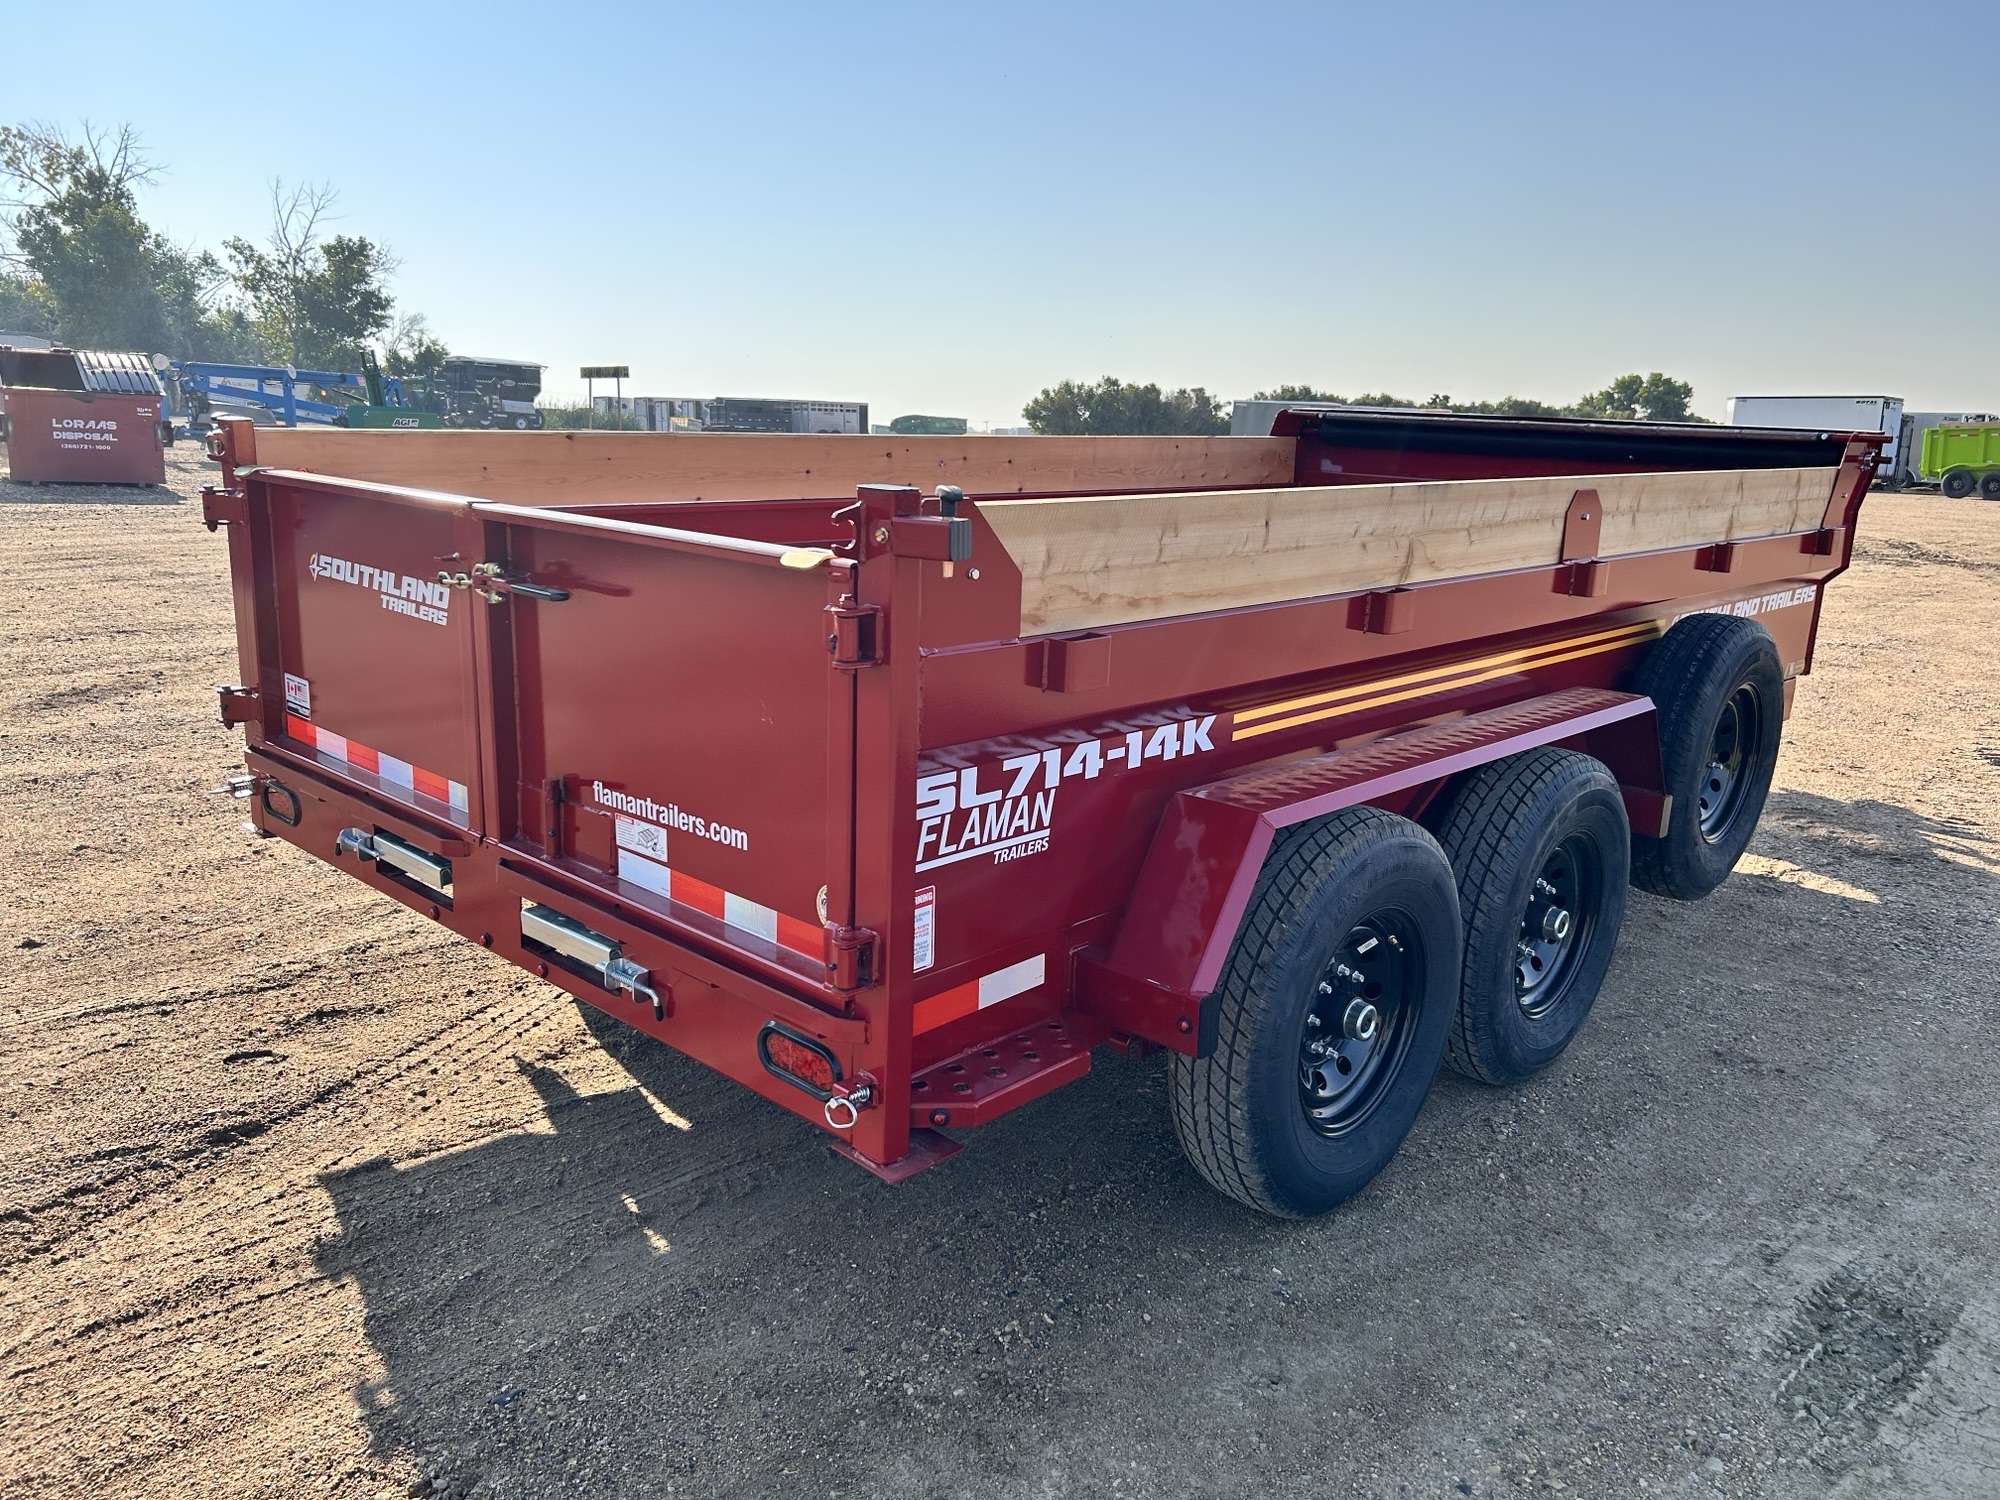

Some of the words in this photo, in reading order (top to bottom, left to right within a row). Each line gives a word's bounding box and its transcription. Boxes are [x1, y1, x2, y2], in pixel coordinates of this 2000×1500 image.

[52, 418, 118, 430] LORAAS
[53, 431, 118, 441] DISPOSAL
[319, 554, 450, 609] SOUTHLAND
[380, 594, 448, 626] TRAILERS
[1760, 584, 1817, 613] TRAILERS
[916, 715, 1217, 821] SL714-14K
[592, 780, 748, 851] flamantrailers.com
[916, 788, 1056, 861] FLAMAN
[993, 836, 1050, 865] TRAILERS
